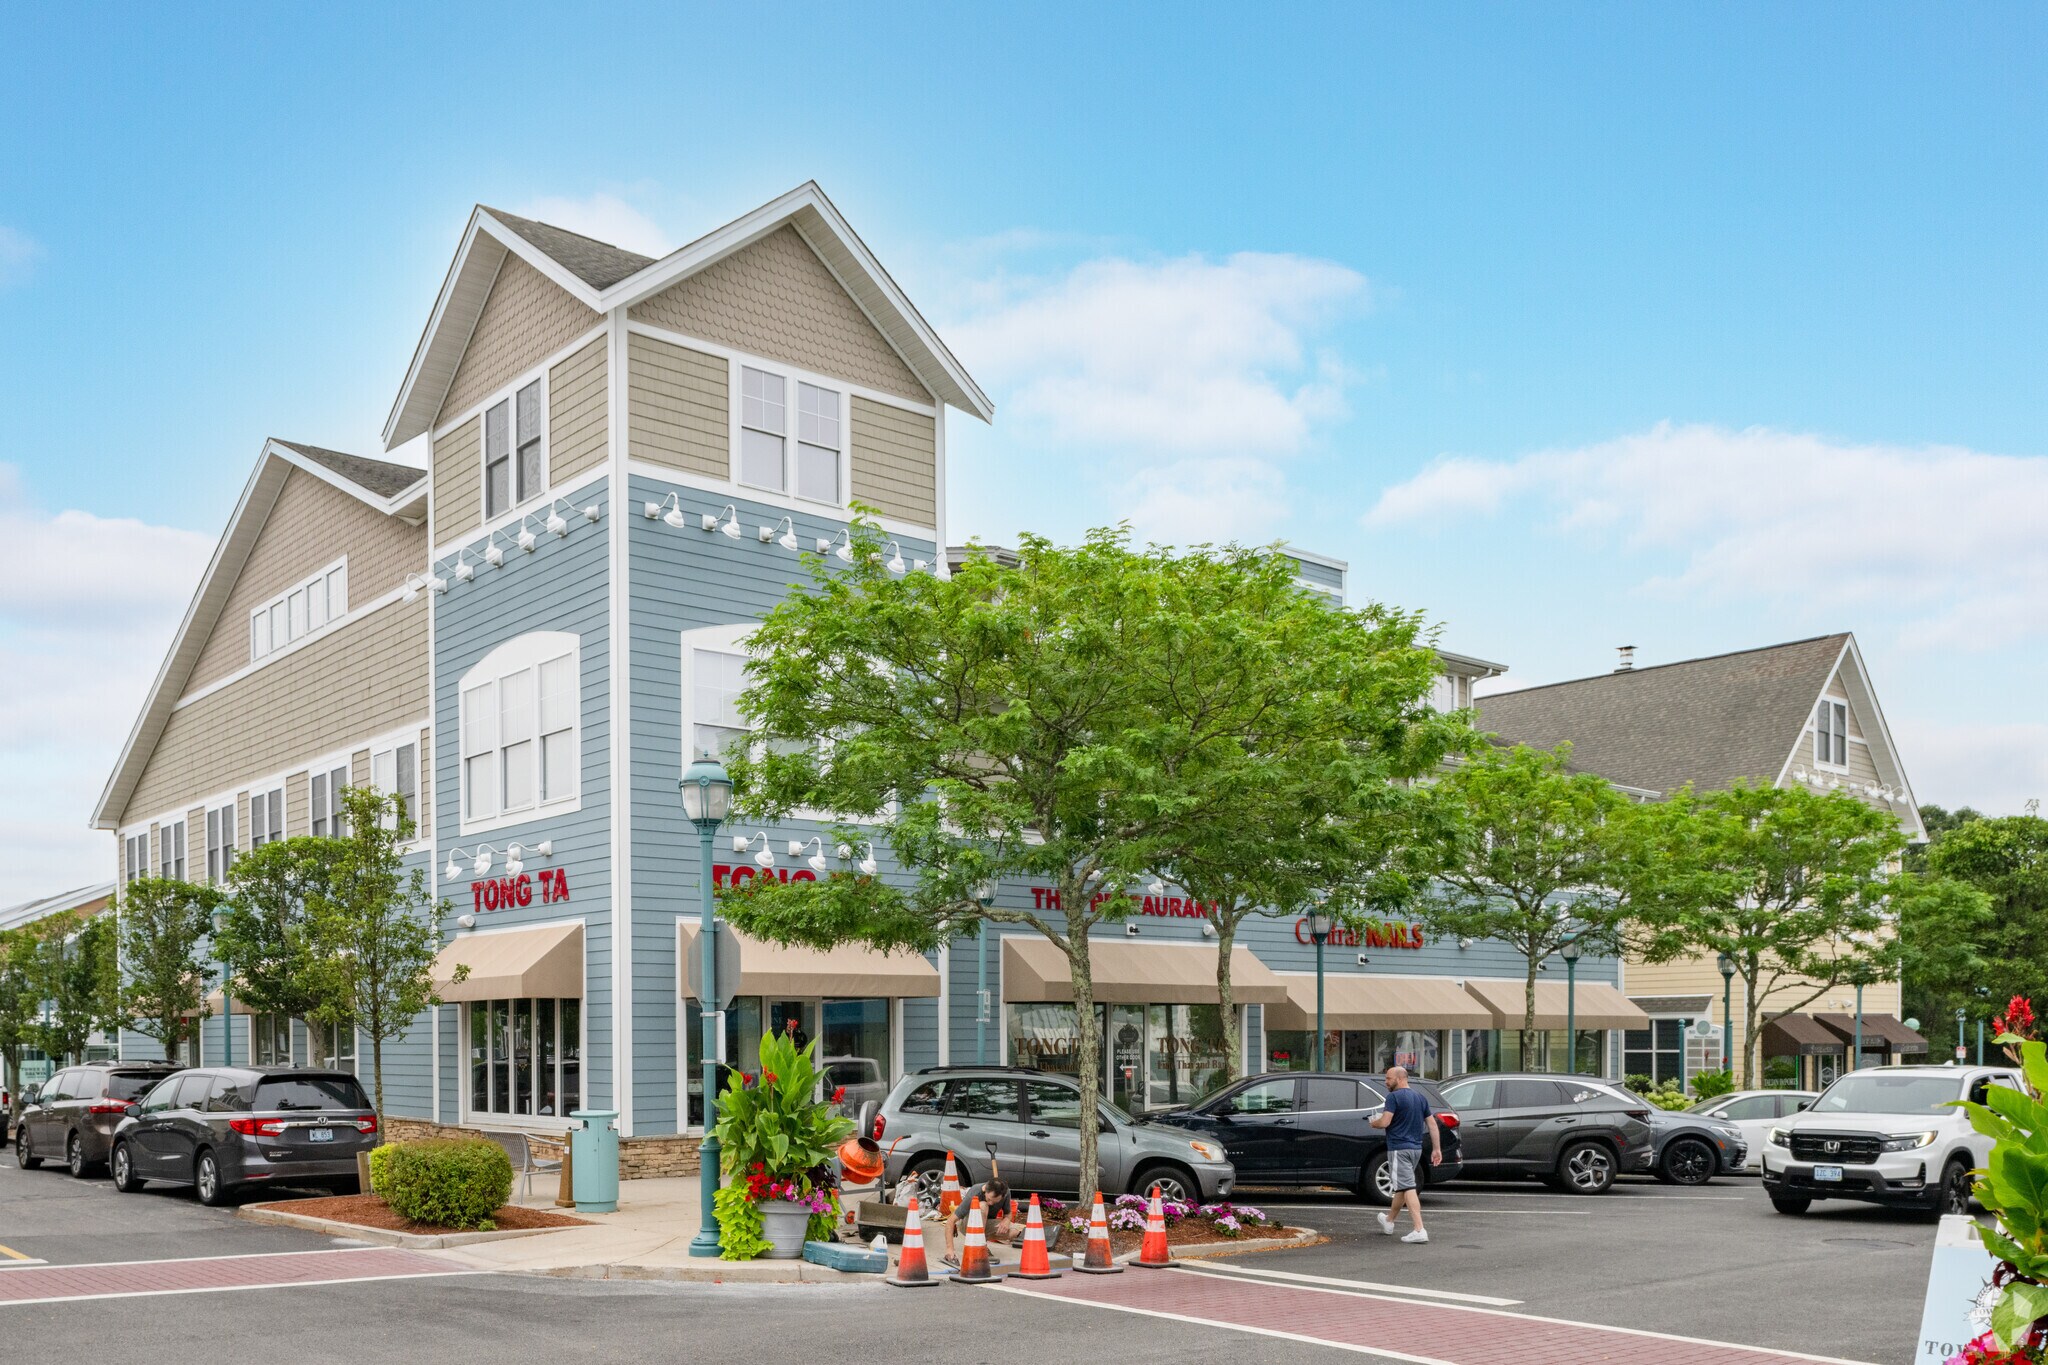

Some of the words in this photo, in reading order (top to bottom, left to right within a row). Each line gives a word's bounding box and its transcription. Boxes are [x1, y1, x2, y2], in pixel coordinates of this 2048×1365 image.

[471, 873, 532, 912] TONG
[538, 868, 570, 904] TA
[1366, 922, 1424, 949] NAILS
[1014, 1037, 1067, 1056] TONG
[1156, 1037, 1201, 1054] TONG
[1178, 1060, 1193, 1069] Thai
